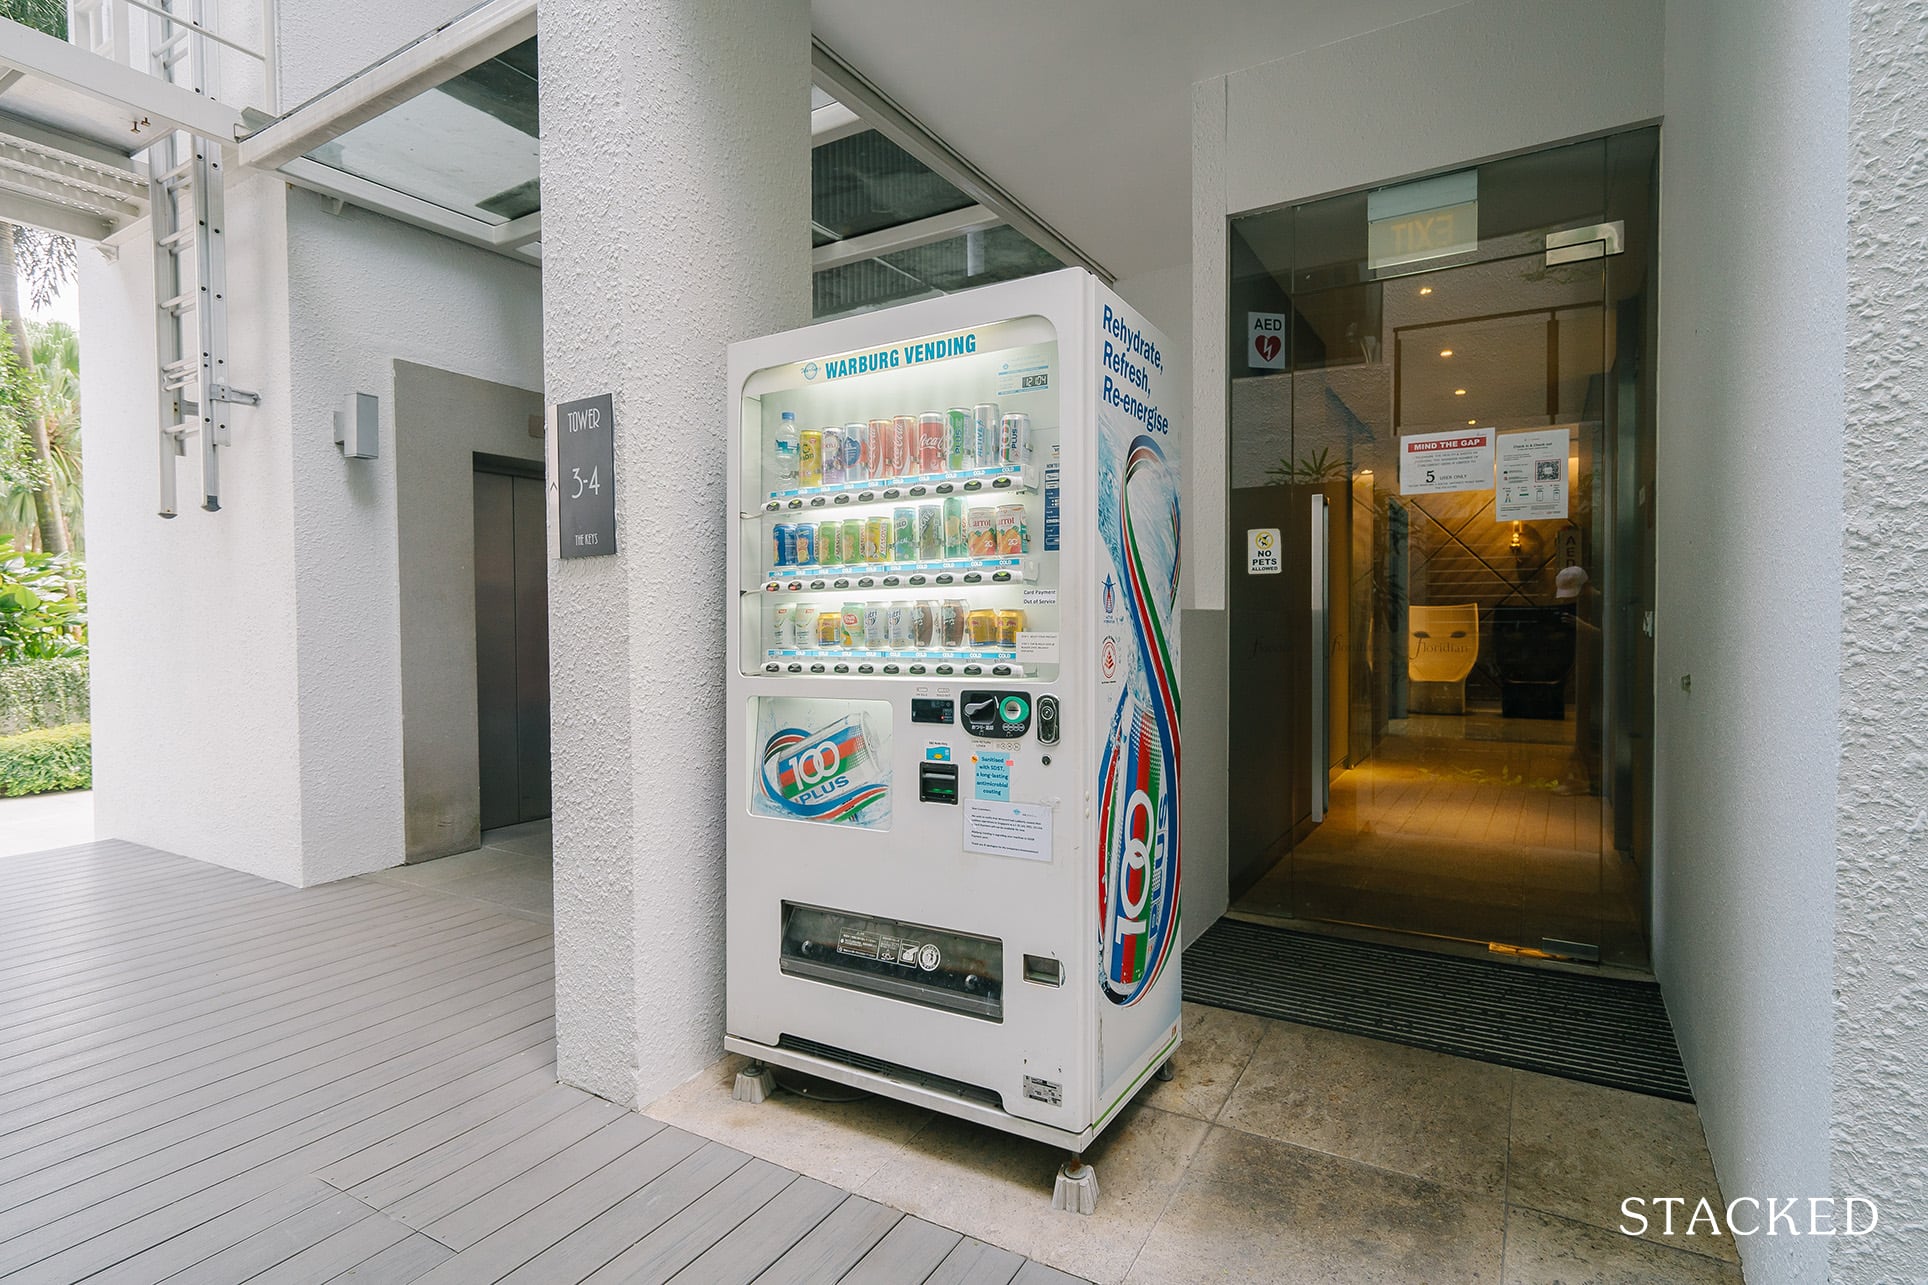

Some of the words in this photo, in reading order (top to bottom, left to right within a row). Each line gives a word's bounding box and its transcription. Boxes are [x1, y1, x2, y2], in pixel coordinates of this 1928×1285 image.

[1254, 318, 1282, 331] AED
[1103, 303, 1164, 376] Rehydrate,
[825, 349, 899, 379] WARBURG
[904, 333, 976, 364] VENDING
[1103, 340, 1151, 399] Refresh,
[1103, 375, 1169, 435] Re-energise
[568, 408, 600, 433] TOWER
[1413, 442, 1437, 451] MIND
[1439, 440, 1458, 449] THE
[1460, 438, 1481, 447] GAP
[571, 465, 600, 499] 3-4
[1425, 470, 1435, 483] 5
[575, 534, 584, 546] THE
[584, 533, 598, 545] KEYS
[1252, 558, 1277, 566] PETS
[1257, 550, 1272, 558] NO
[1035, 589, 1056, 597] Payment
[788, 740, 841, 791] 100
[799, 775, 850, 805] PLUS
[983, 788, 1001, 796] coating
[1115, 789, 1155, 945] 100
[1149, 792, 1168, 943] PLUS
